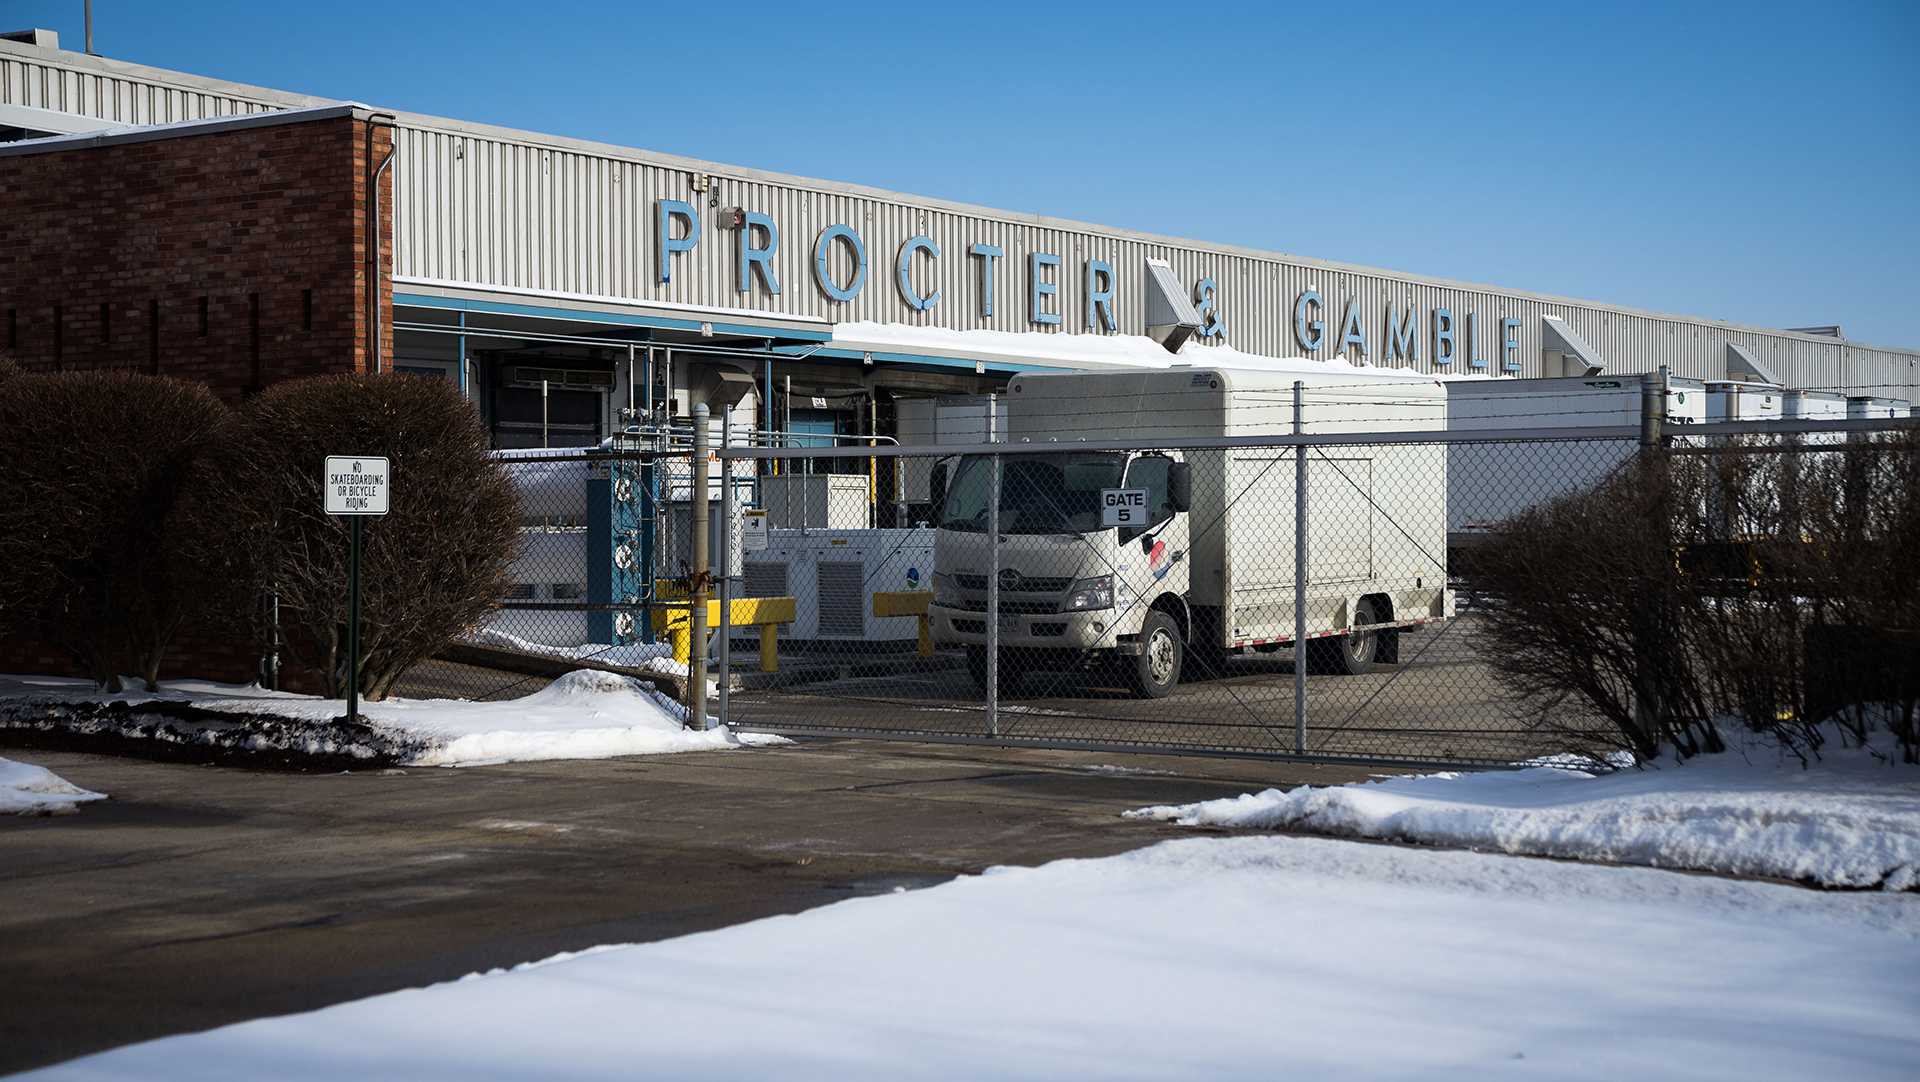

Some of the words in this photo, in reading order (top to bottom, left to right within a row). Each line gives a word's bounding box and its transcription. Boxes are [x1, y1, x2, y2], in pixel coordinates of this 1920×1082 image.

[655, 199, 1117, 332] PROCTER
[1194, 277, 1227, 339] &
[1294, 290, 1522, 371] GAMBLE
[352, 462, 362, 473] NO
[330, 474, 384, 485] SKATEBOARDING
[337, 486, 347, 496] OR
[349, 486, 376, 496] BICYCLE
[345, 498, 368, 508] RIDING
[1105, 493, 1144, 506] GATE
[1118, 509, 1130, 521] 5
